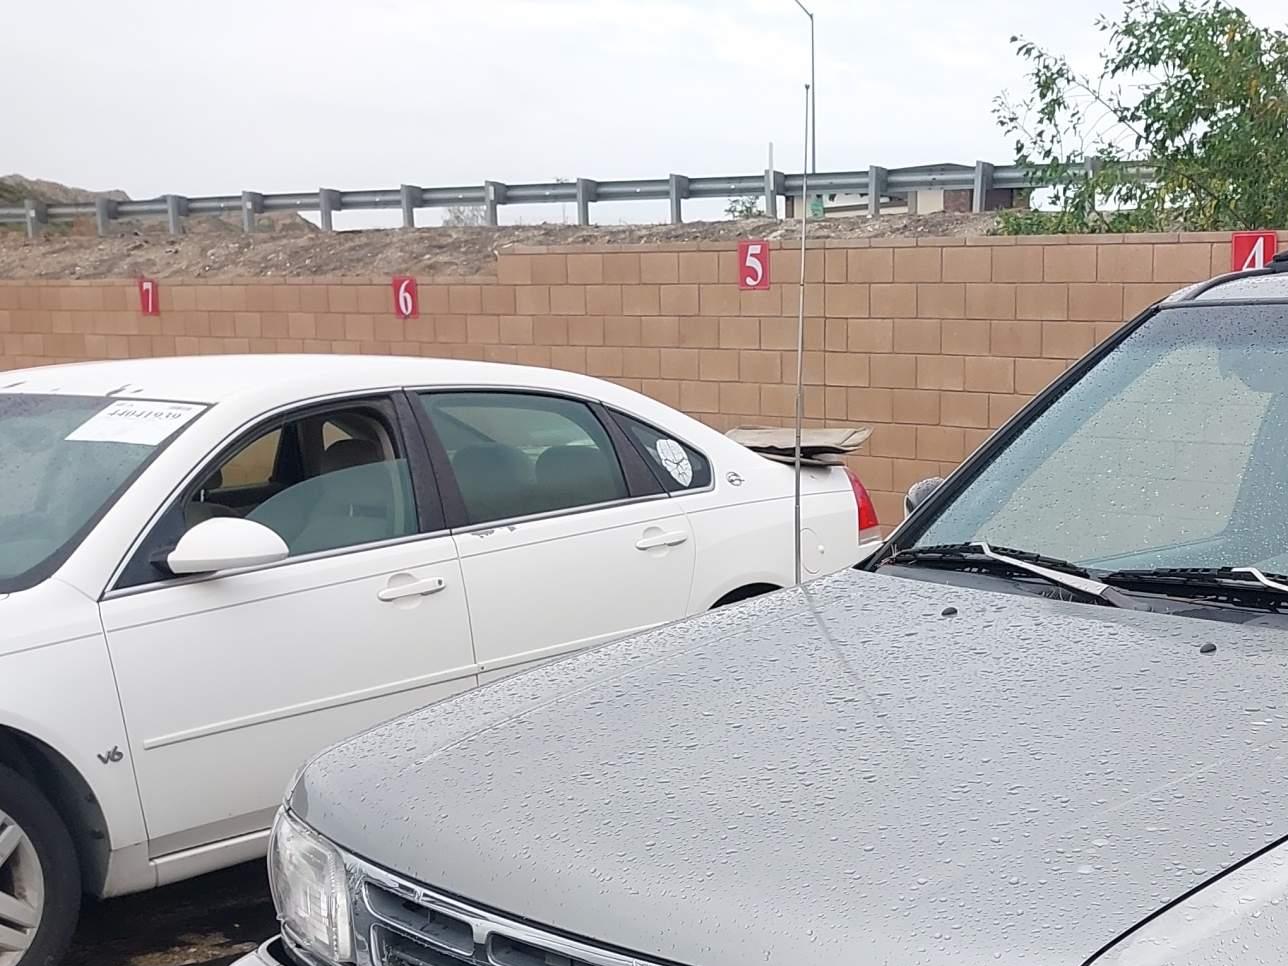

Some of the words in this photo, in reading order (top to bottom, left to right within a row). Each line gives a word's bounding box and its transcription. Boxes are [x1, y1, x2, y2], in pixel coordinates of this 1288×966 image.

[745, 244, 763, 287] 5
[1242, 236, 1273, 272] 4
[143, 281, 153, 313] 7
[399, 280, 413, 316] 6
[97, 745, 124, 765] V6
